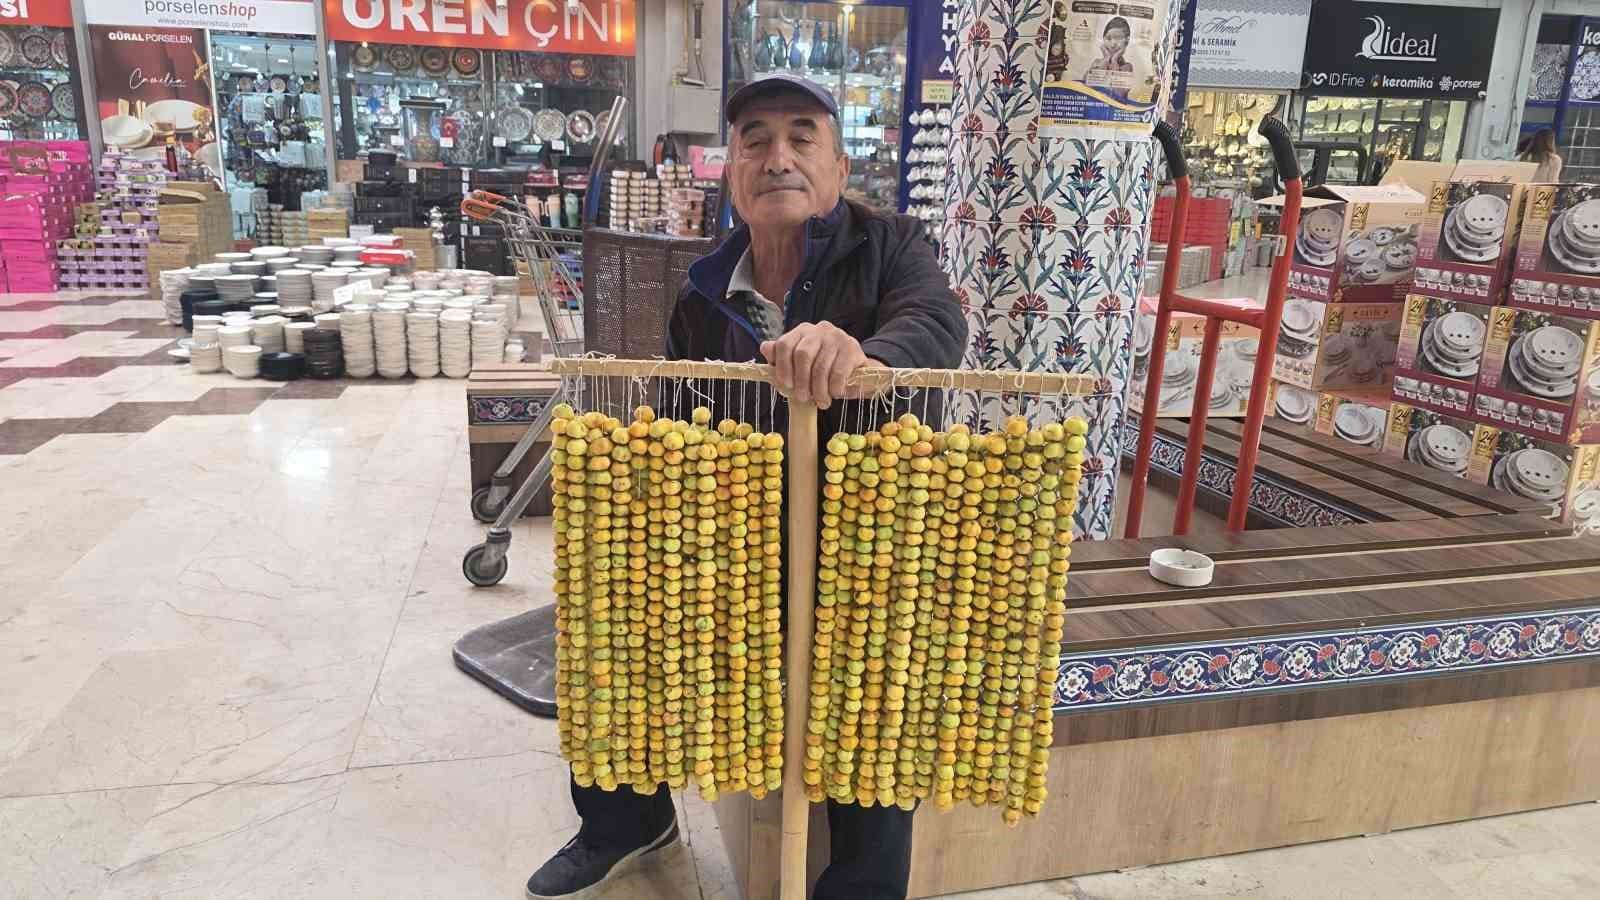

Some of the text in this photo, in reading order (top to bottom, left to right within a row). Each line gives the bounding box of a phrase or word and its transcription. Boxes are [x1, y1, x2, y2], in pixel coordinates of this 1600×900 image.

[144, 0, 257, 20] porselenshop
[108, 30, 193, 44] GÜRAL PORSELEN
[1383, 26, 1438, 57] ideal
[1342, 73, 1366, 88] Fine
[1382, 75, 1434, 89] keramika
[1409, 301, 1425, 314] 24
[1495, 311, 1513, 326] 24
[1478, 430, 1496, 445] 24
